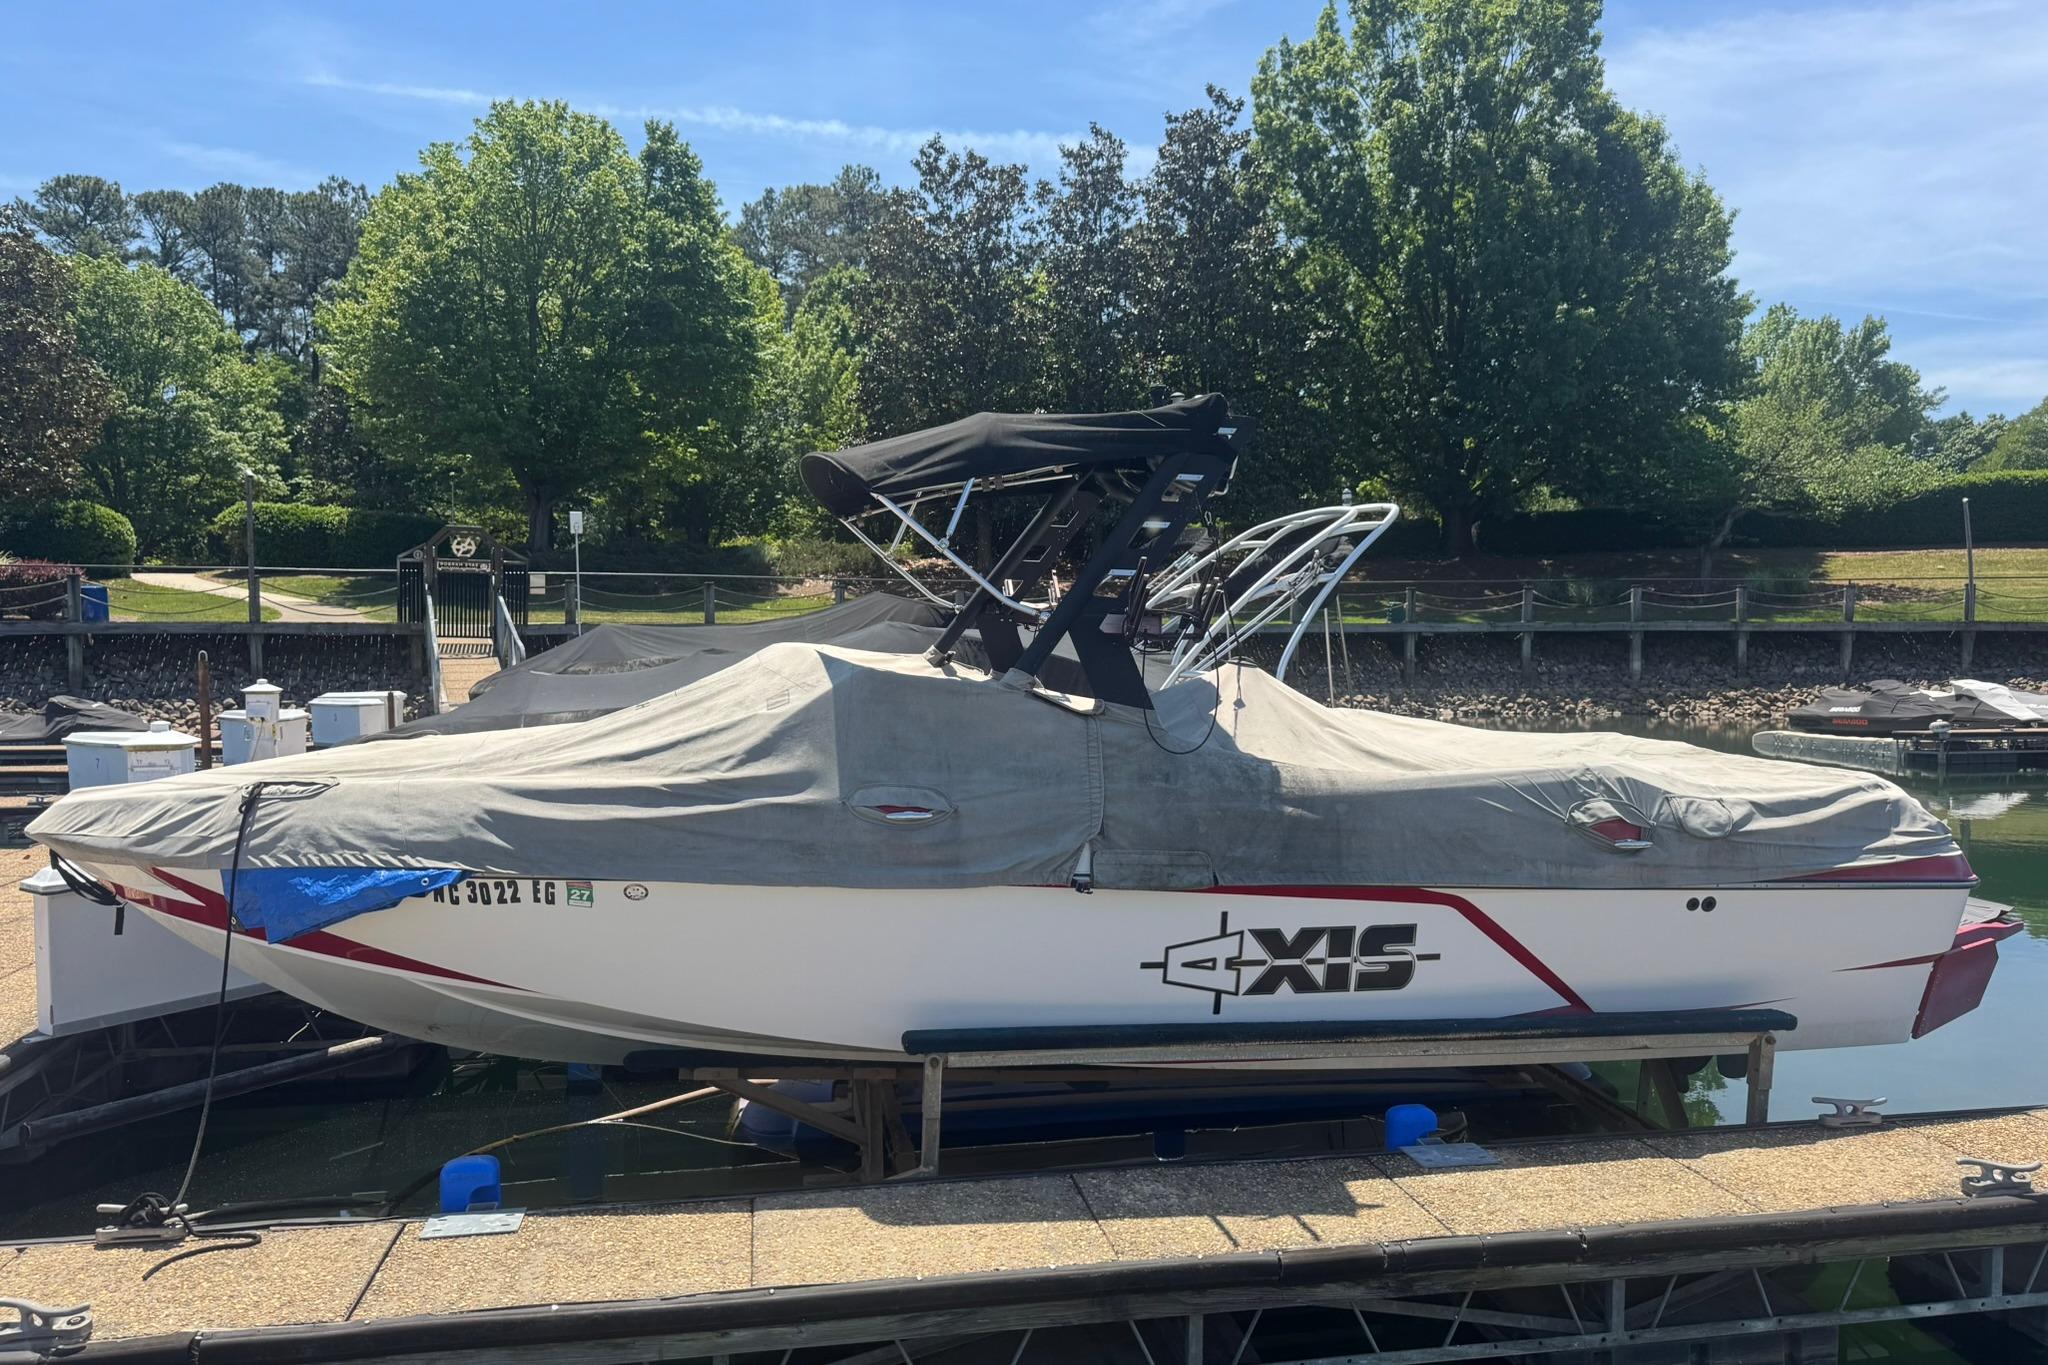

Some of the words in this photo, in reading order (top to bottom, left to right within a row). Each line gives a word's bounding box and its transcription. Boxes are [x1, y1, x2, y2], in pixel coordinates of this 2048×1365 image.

[95, 757, 100, 769] 7
[433, 884, 460, 905] NC
[466, 880, 521, 905] 3022
[532, 879, 555, 905] EG
[570, 889, 590, 901] 27
[1161, 923, 1418, 996] AXIS
